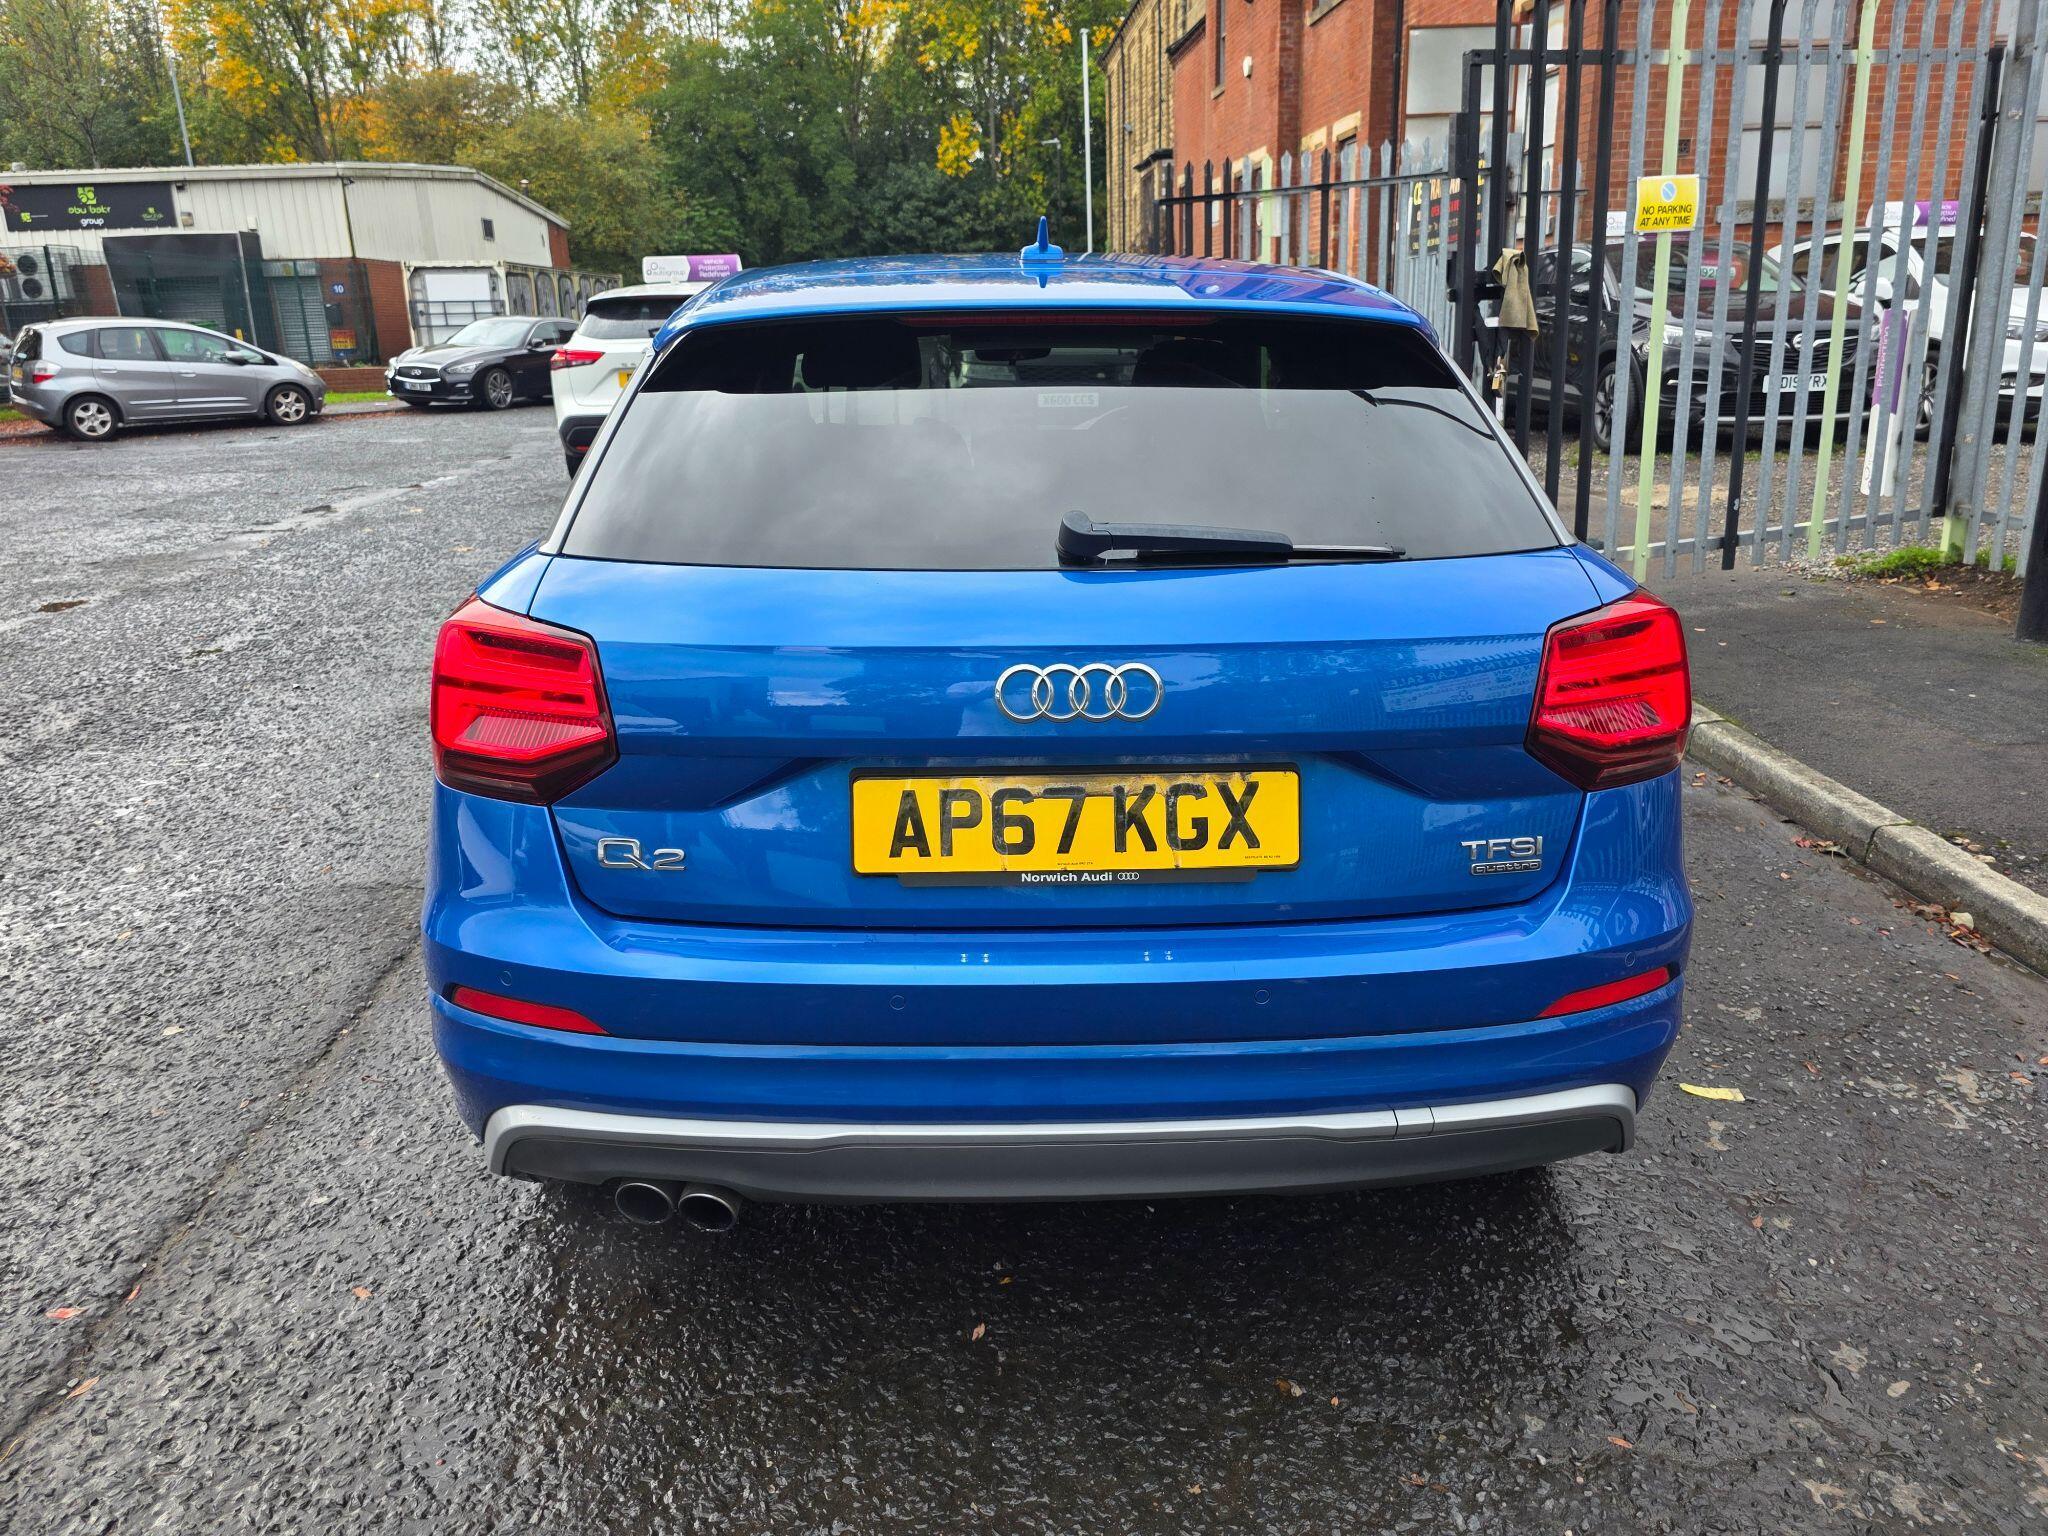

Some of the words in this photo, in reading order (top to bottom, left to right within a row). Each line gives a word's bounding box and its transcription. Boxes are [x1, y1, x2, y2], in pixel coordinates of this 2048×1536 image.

[1642, 206, 1655, 215] NO
[1658, 204, 1692, 215] PARKING
[80, 218, 104, 227] group
[1640, 217, 1650, 227] AT
[1652, 217, 1670, 226] ANY
[1674, 215, 1691, 225] TIME
[333, 284, 344, 294] 10
[889, 786, 1087, 858] AP67
[1114, 781, 1261, 853] KGX
[1461, 836, 1543, 860] TFSI
[597, 837, 685, 871] Q2
[1475, 862, 1540, 873] quattro
[1021, 872, 1077, 882] Norwich
[1081, 871, 1113, 882] Audi
